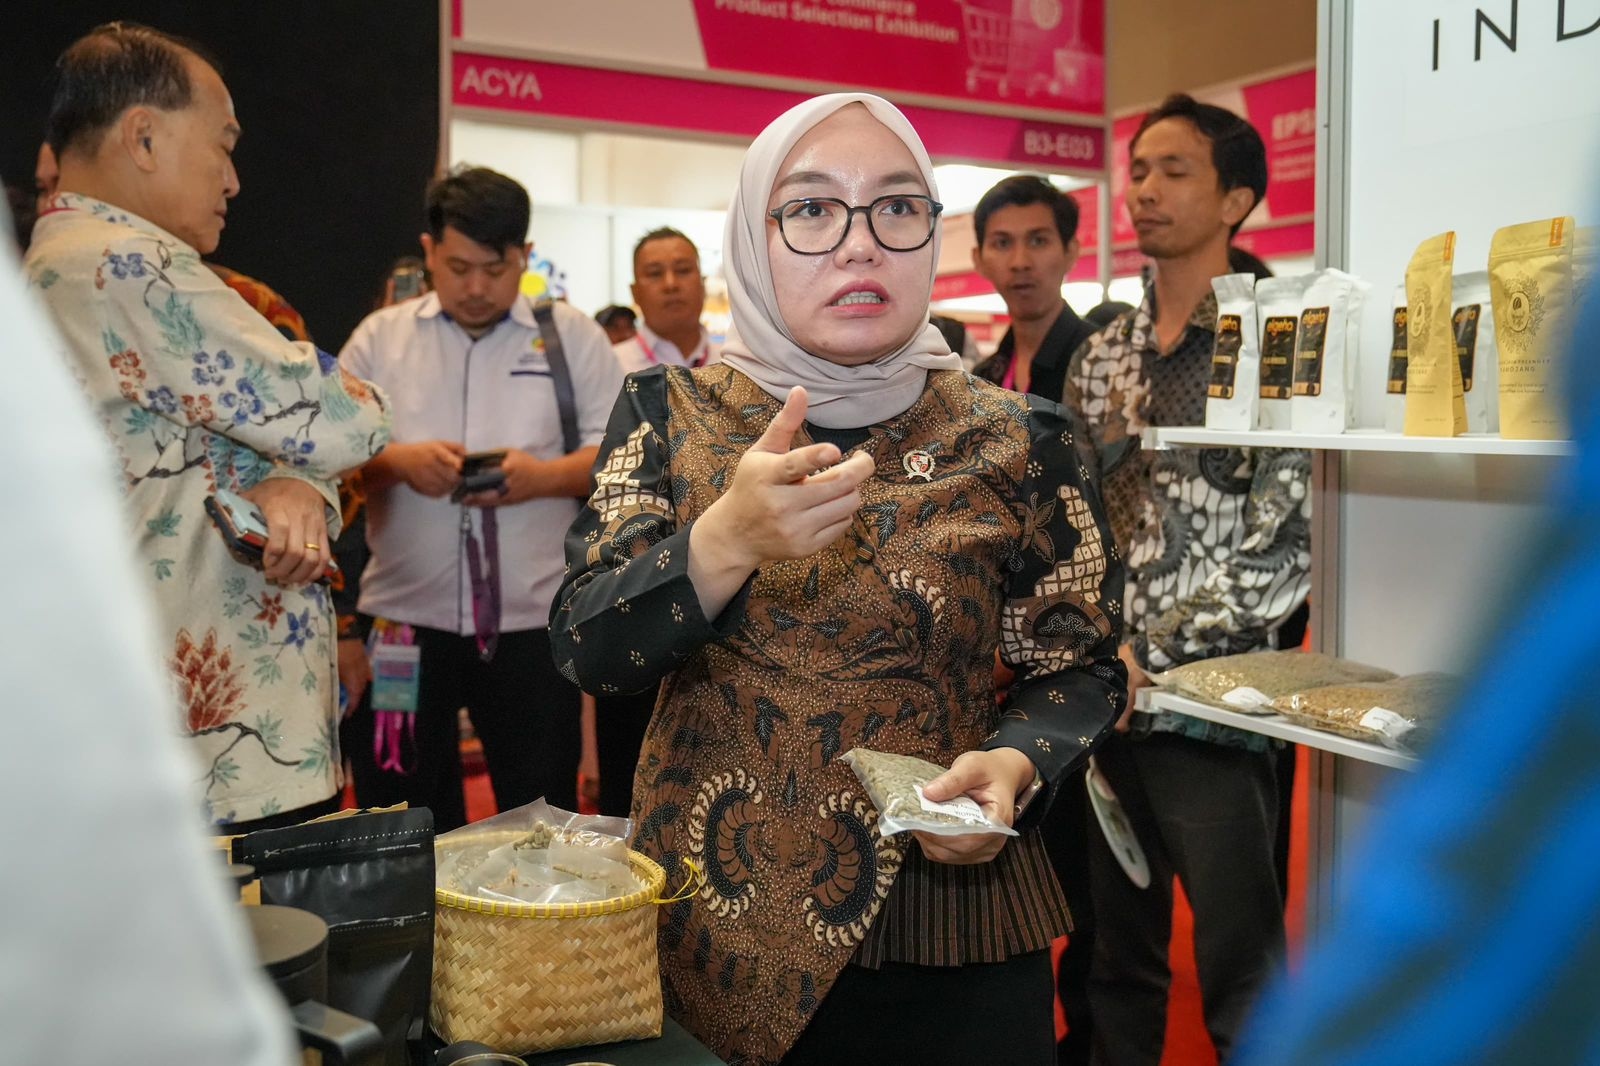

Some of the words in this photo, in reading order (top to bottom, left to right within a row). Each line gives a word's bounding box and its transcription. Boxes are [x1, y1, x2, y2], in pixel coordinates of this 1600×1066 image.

[791, 1, 873, 30] Selection
[875, 14, 960, 43] Exhibition
[459, 65, 543, 102] ACYA
[1024, 129, 1095, 160] B3-E03
